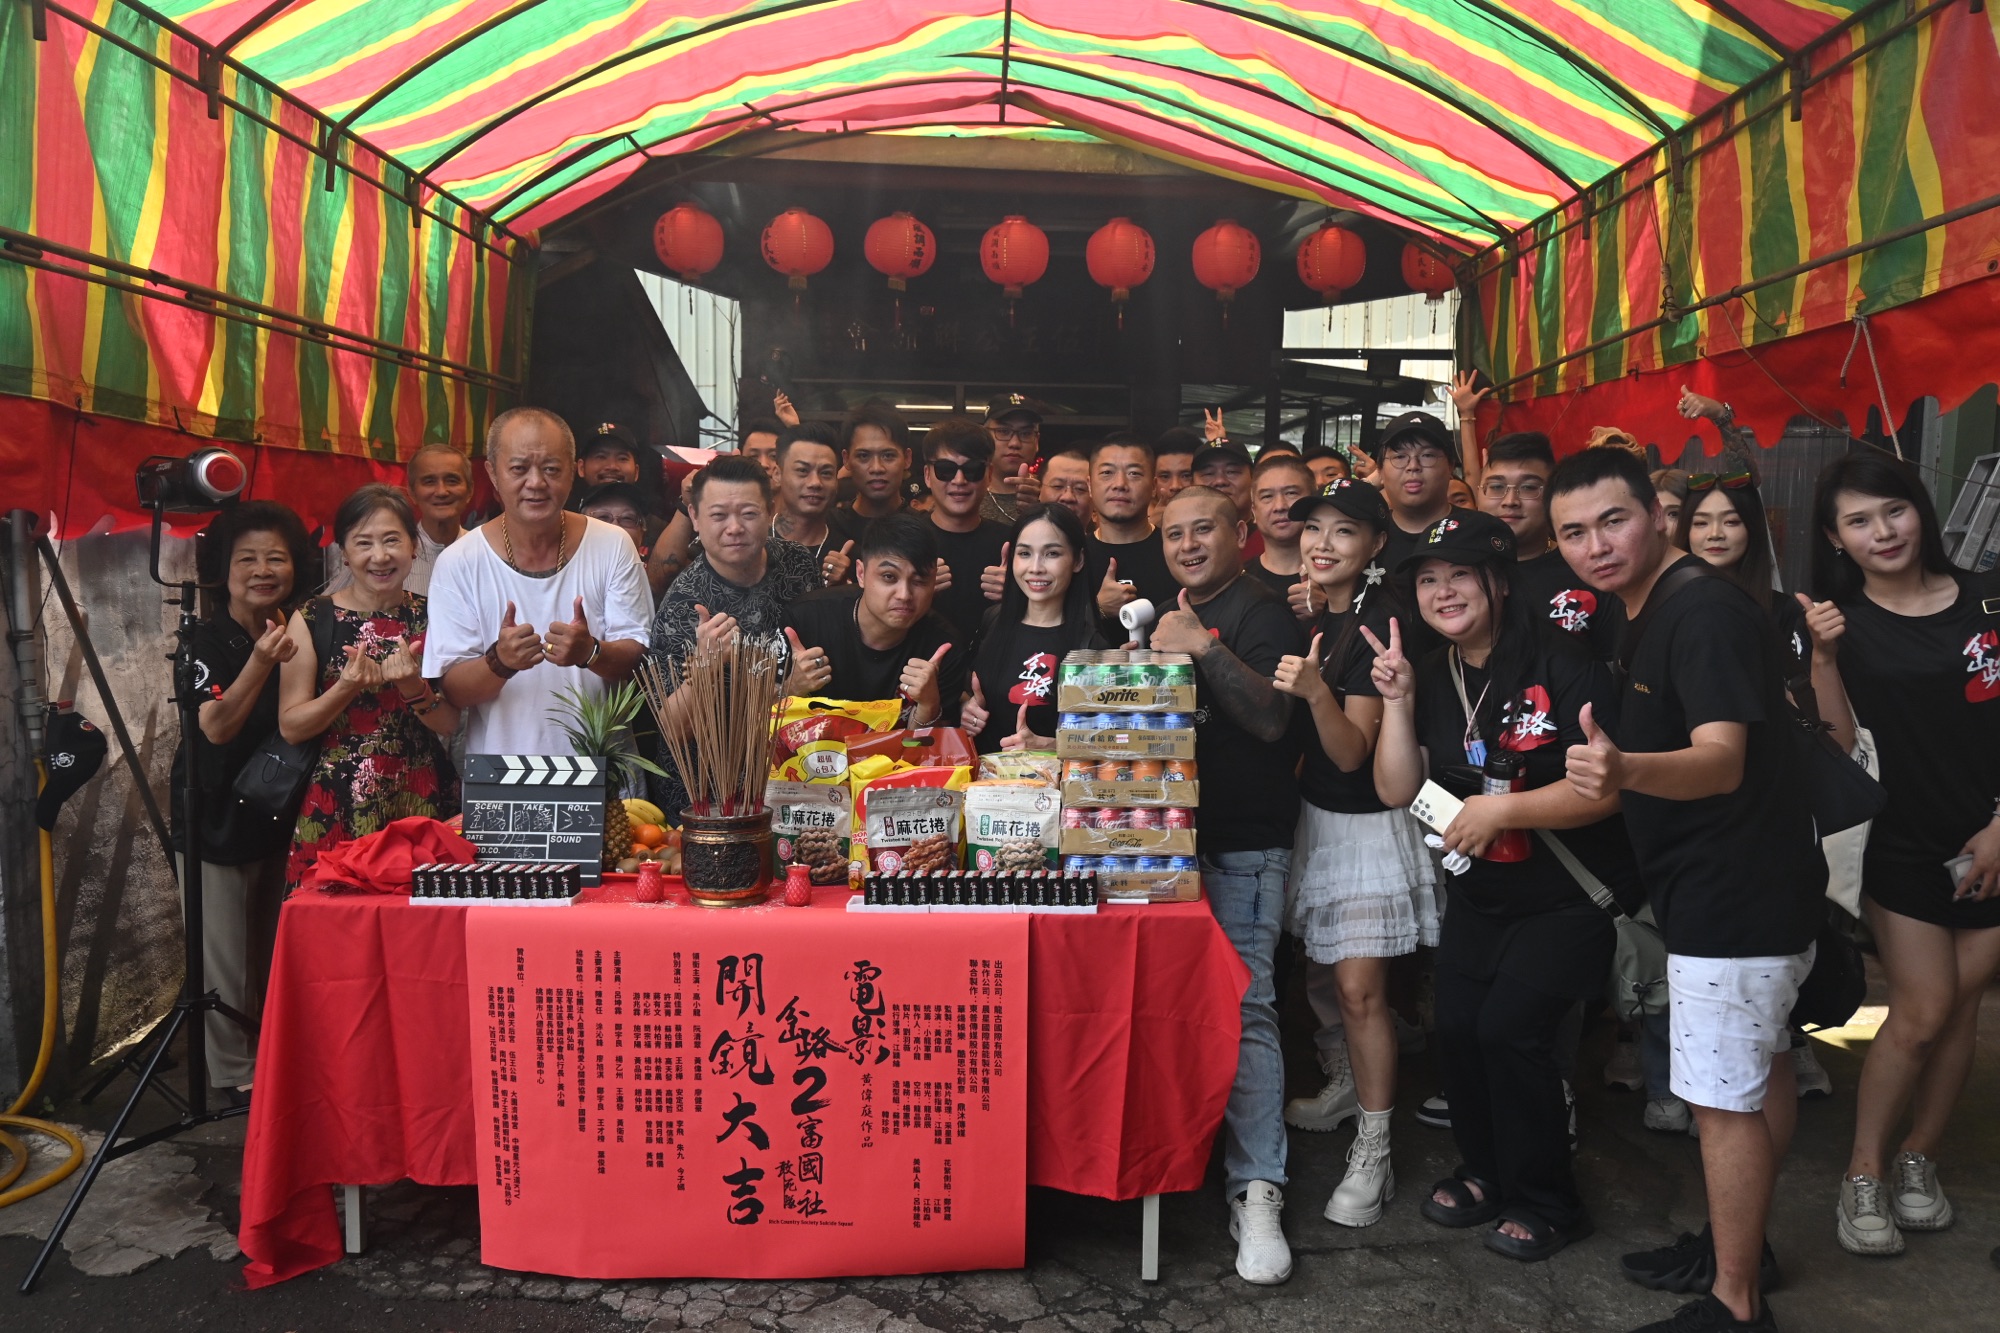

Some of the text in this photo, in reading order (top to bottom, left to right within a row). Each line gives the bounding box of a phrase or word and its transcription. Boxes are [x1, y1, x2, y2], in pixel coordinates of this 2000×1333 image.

[1097, 689, 1138, 704] Sprite
[1067, 734, 1085, 742] FIN
[817, 755, 832, 763] 超值
[815, 765, 837, 774] 6包入
[567, 804, 590, 812] ROLL
[792, 809, 835, 827] 麻花捲
[896, 816, 945, 836] 麻花捲
[991, 819, 1041, 838] 麻花捲
[550, 835, 582, 843] SOUND
[842, 960, 891, 1066] 電影
[708, 953, 775, 1225] 開鏡大吉
